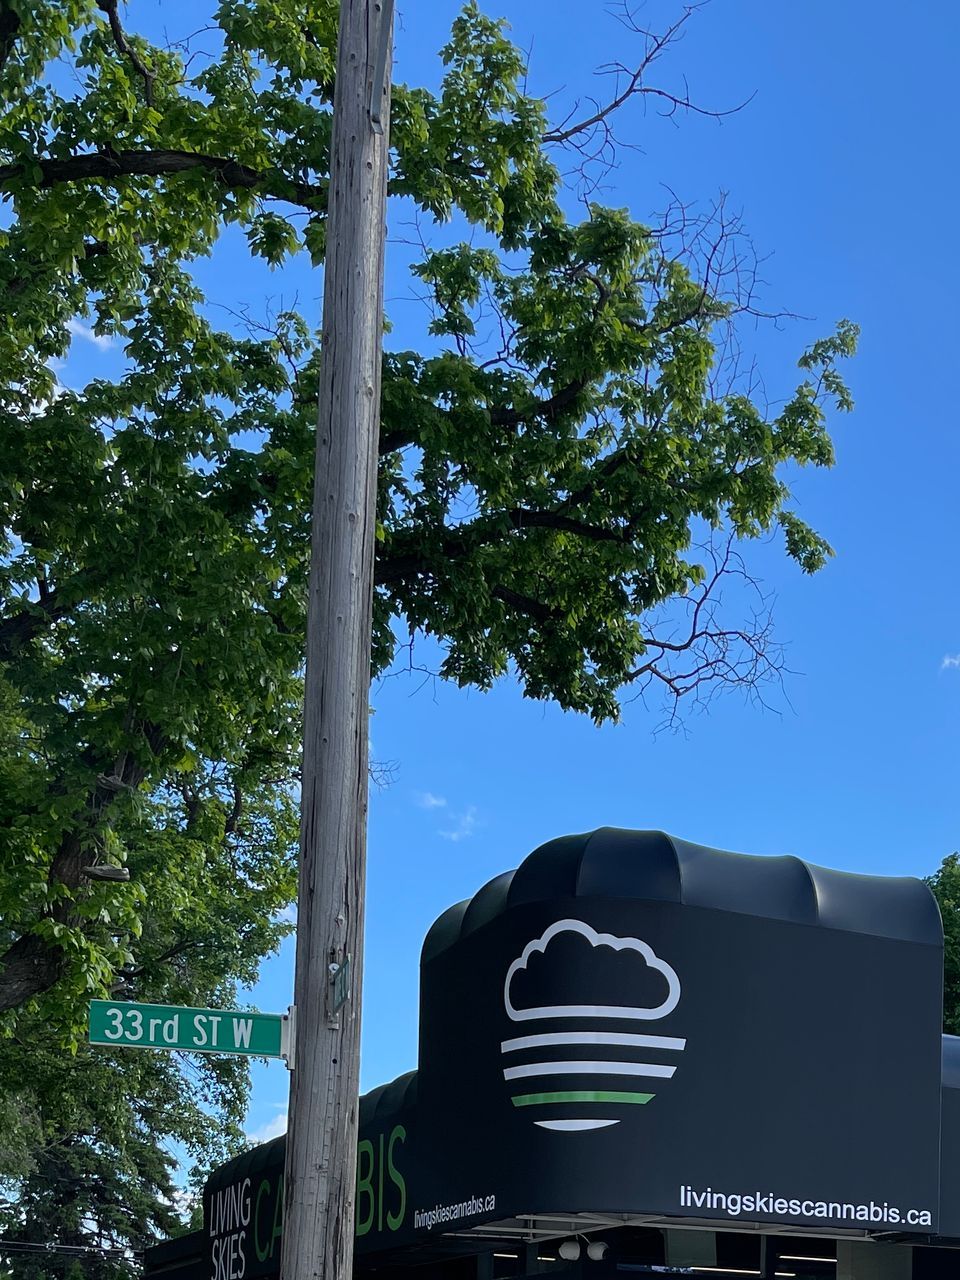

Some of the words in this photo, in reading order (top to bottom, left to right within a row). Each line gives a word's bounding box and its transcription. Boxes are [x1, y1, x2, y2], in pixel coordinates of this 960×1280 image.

[104, 1008, 179, 1043] 33rd
[193, 1014, 221, 1046] ST
[233, 1018, 253, 1049] W
[209, 1177, 251, 1237] LIVING
[414, 1194, 496, 1230] livingskiescannabis.ca
[680, 1185, 932, 1226] livingskiescannabis.ca
